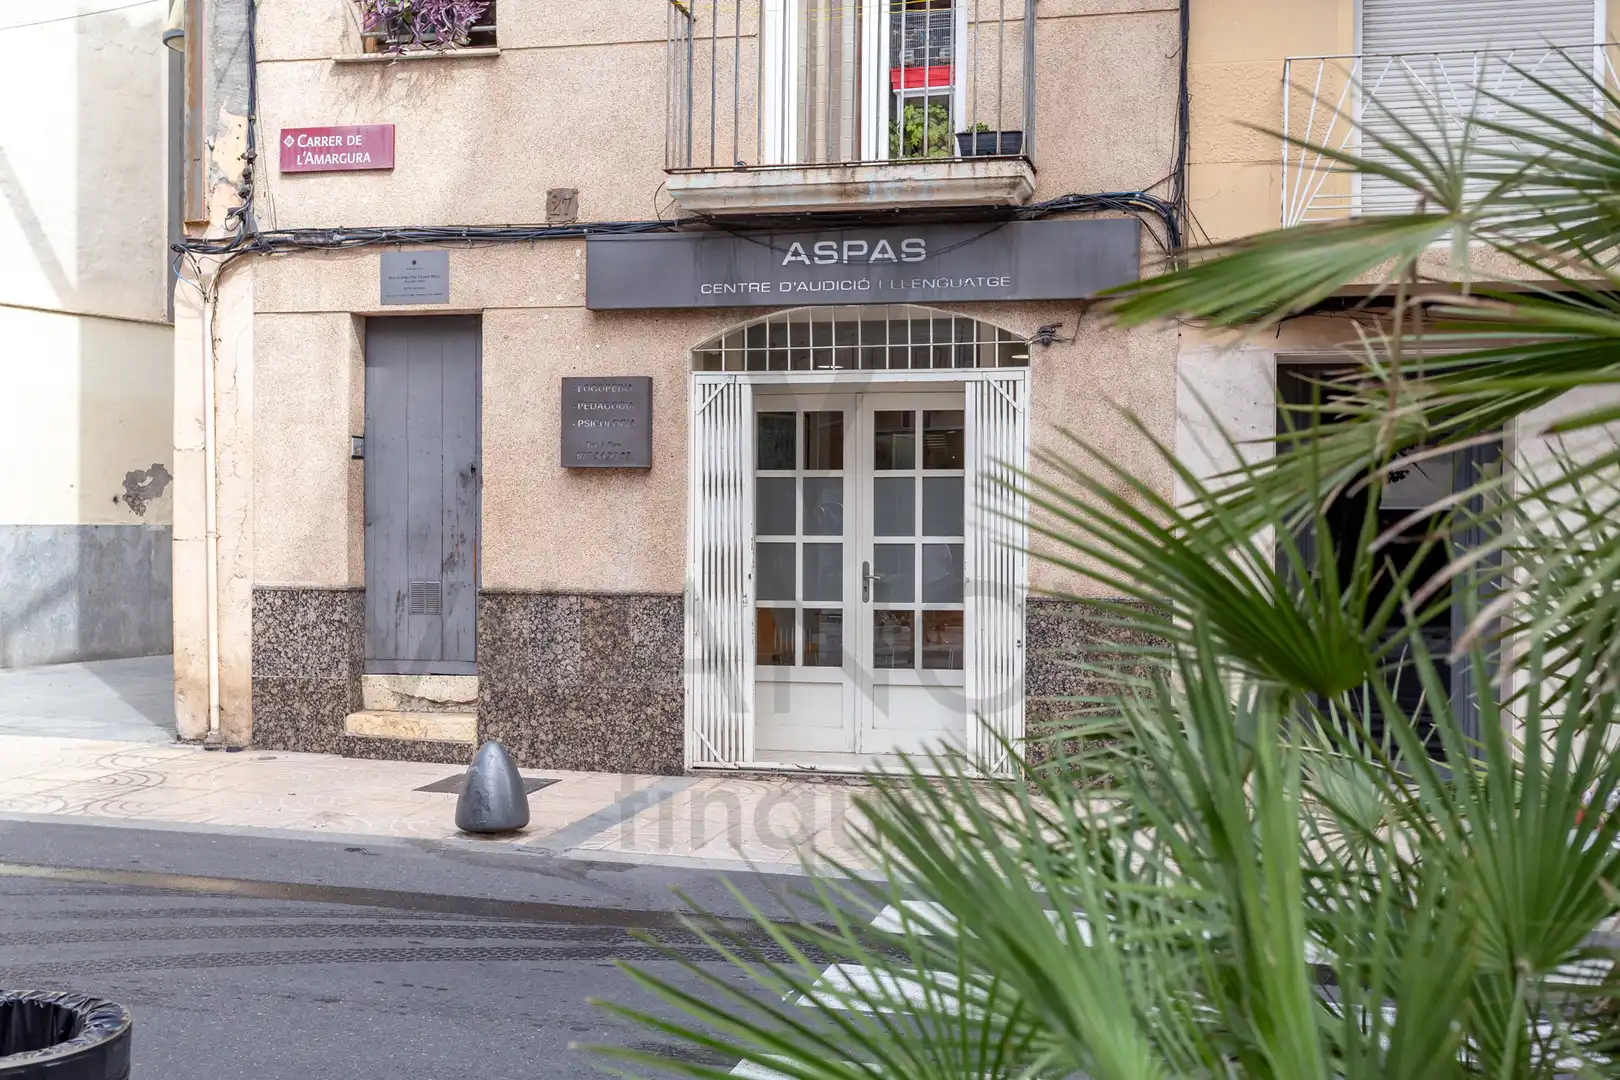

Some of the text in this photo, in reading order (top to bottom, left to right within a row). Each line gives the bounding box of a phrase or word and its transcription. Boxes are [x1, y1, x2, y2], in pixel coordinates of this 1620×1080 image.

[781, 237, 927, 267] ASPAS
[700, 281, 772, 295] CENTRE
[779, 277, 871, 292] D'AUDICIÓ
[890, 276, 1012, 290] LLENGUATGE
